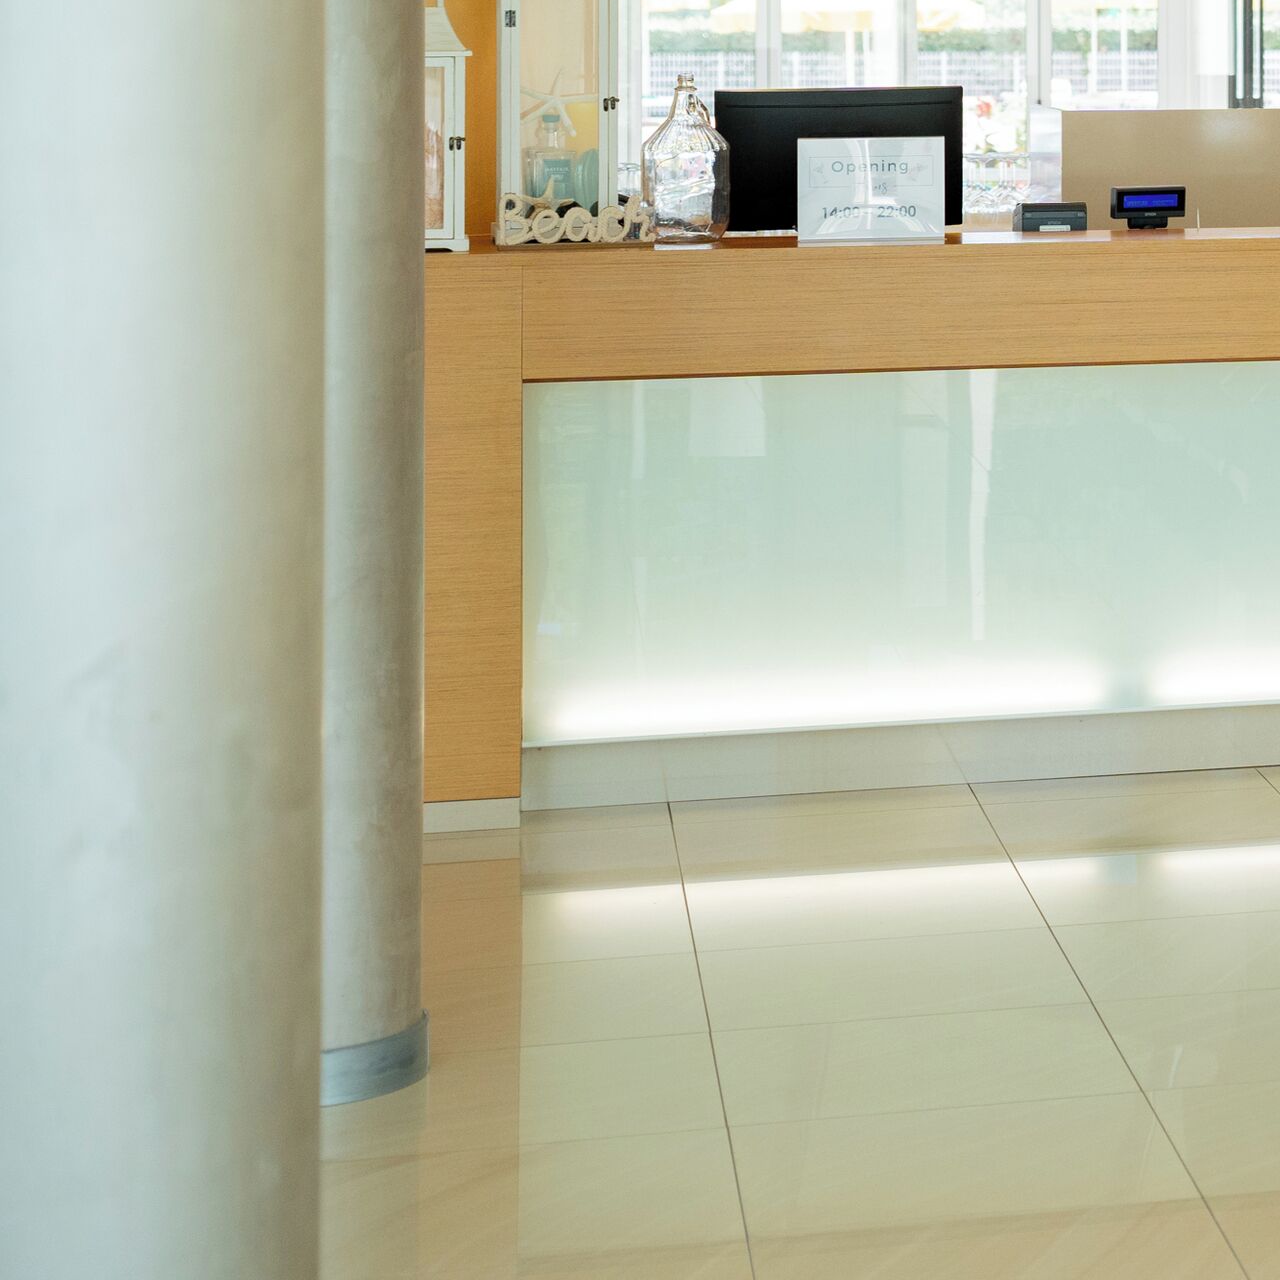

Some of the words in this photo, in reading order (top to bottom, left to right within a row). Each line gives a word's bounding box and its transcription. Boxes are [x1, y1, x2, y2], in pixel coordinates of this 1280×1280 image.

[831, 160, 908, 174] Opening
[877, 205, 917, 218] 22:00
[500, 192, 657, 246] Beach
